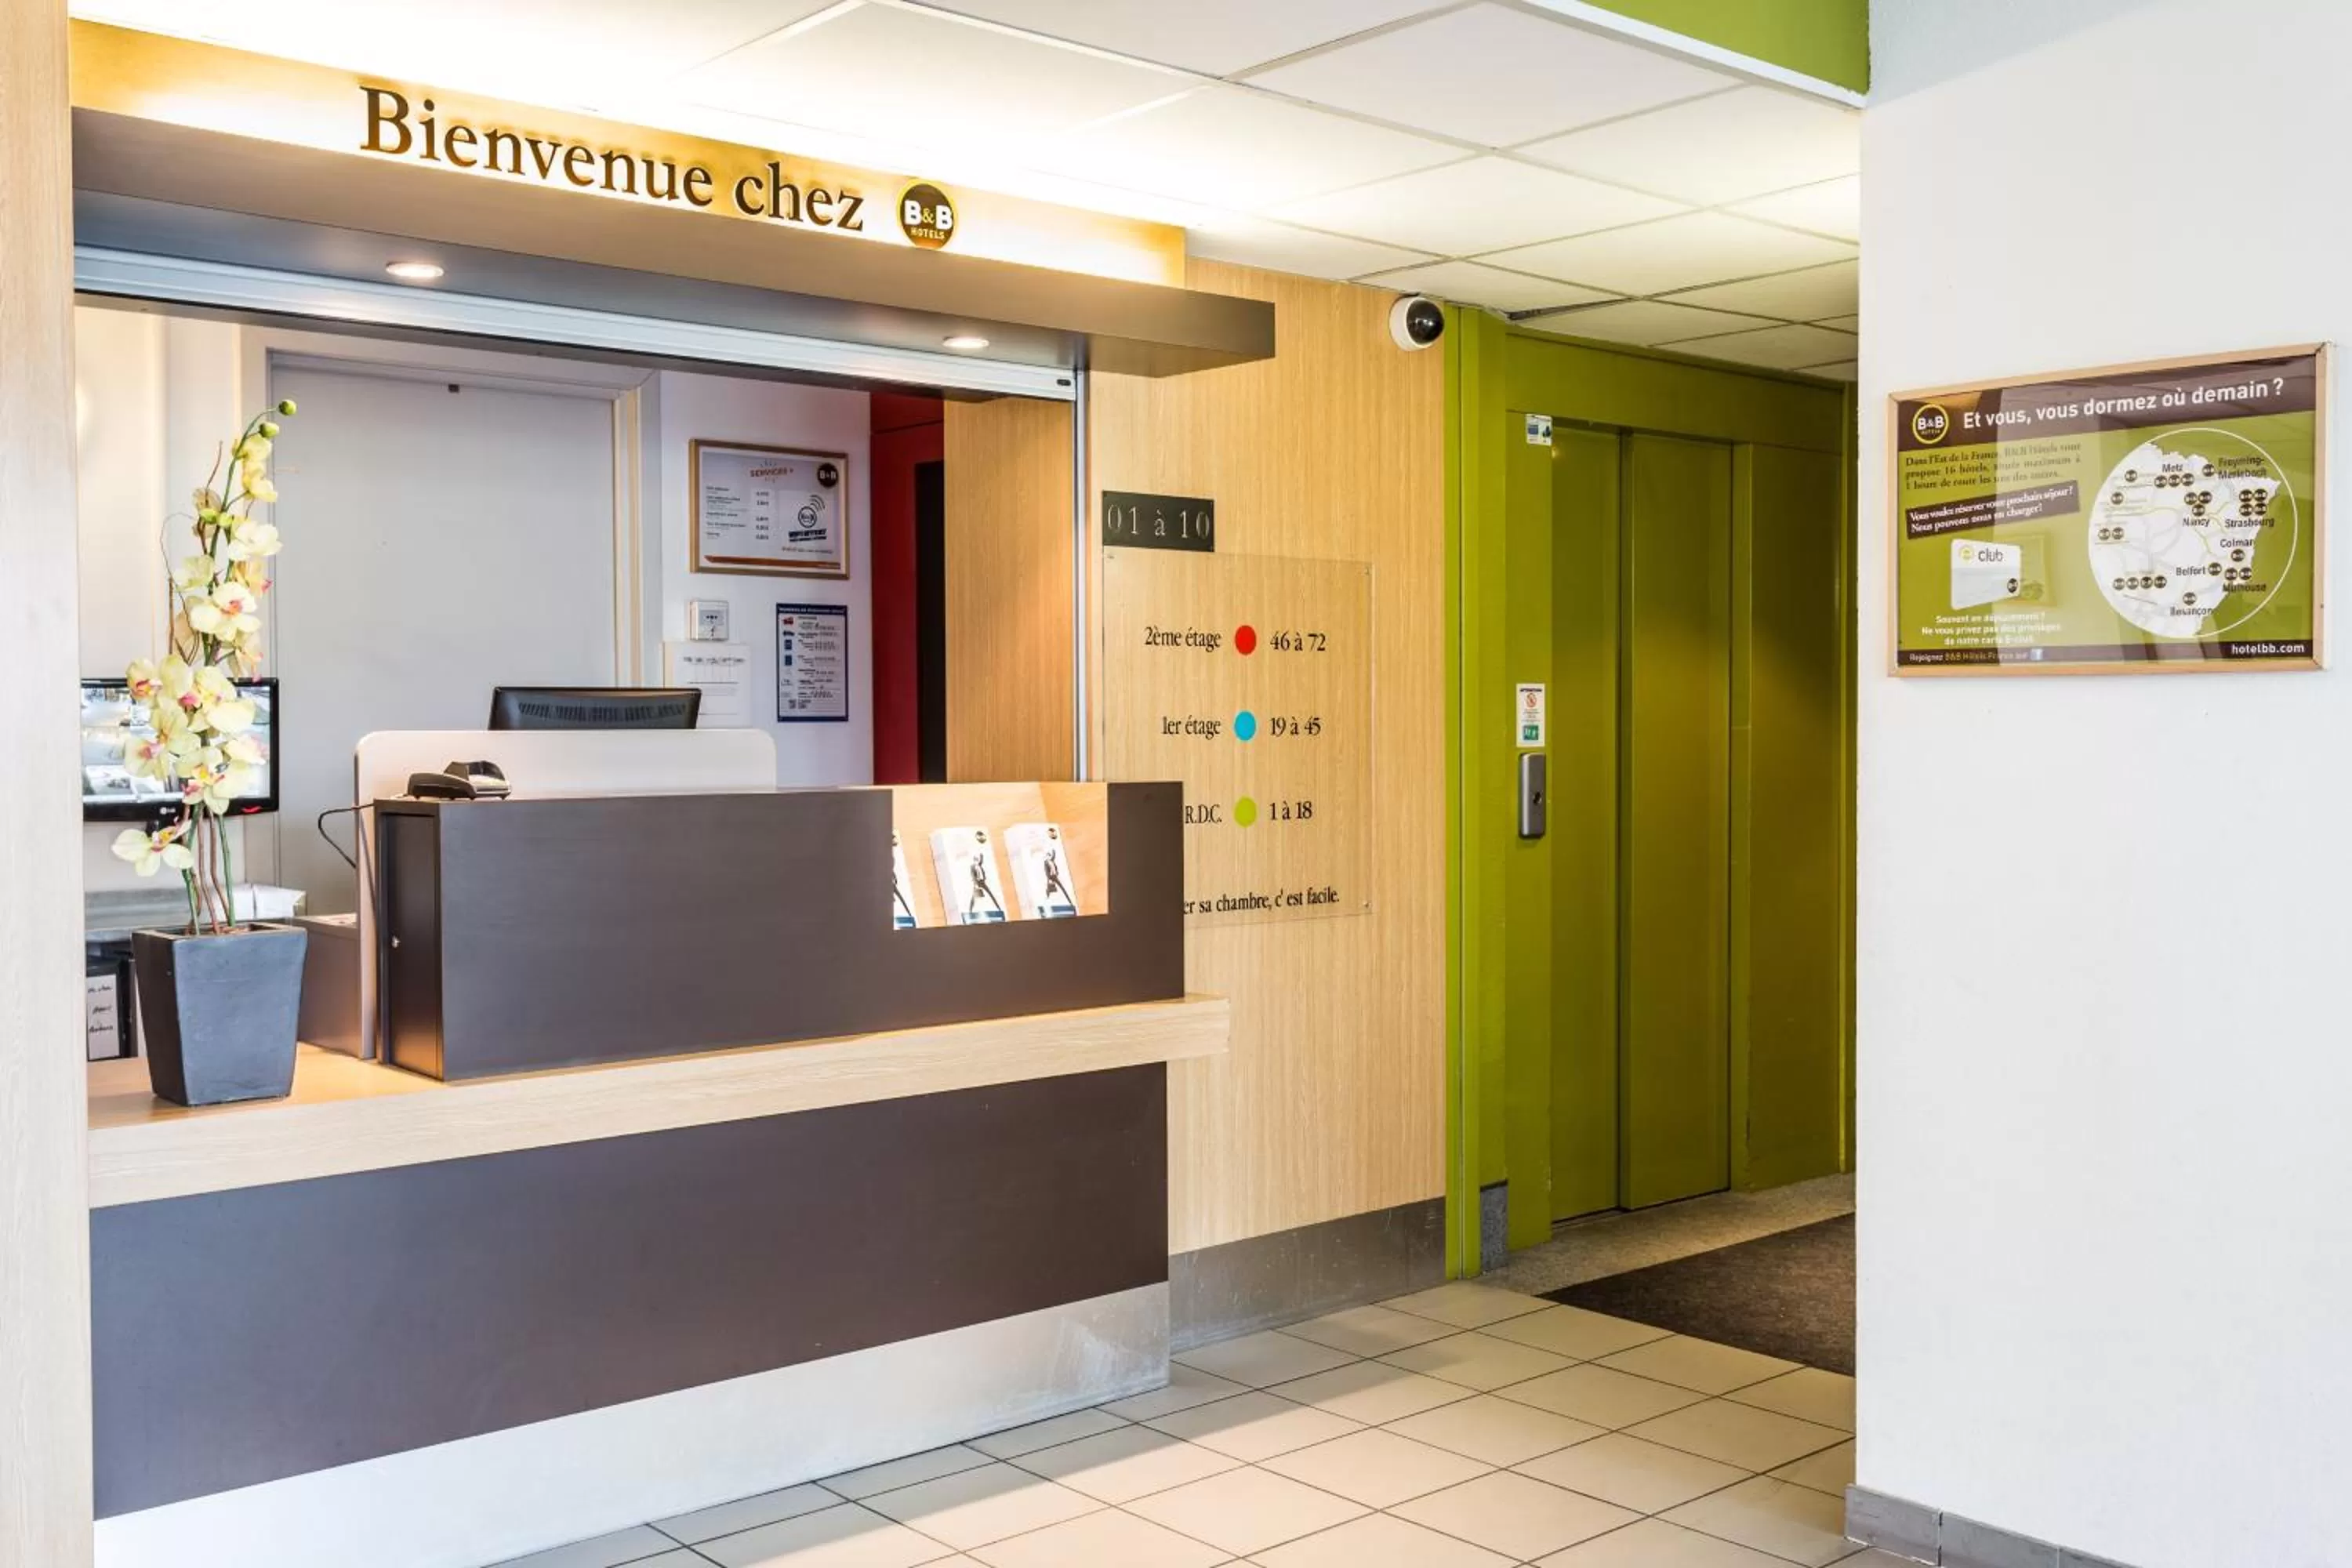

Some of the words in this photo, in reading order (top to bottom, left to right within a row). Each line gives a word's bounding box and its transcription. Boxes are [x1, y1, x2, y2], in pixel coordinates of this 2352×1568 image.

[359, 85, 713, 206] Bienvenue
[735, 162, 865, 230] chez
[905, 199, 953, 230] B&B
[1963, 412, 1980, 429] Et
[1986, 409, 2031, 426] vous,
[2036, 404, 2078, 420] vous
[2084, 395, 2157, 416] dormez
[2162, 387, 2186, 407] où
[2192, 381, 2268, 404] demain
[2274, 377, 2284, 395] ?
[1917, 415, 1944, 430] B&B
[2162, 463, 2183, 473] Metz
[1107, 504, 1140, 535] 01
[1153, 508, 1166, 536] à
[1179, 510, 1210, 539] 10
[1910, 511, 1929, 521] Vous
[2183, 517, 2210, 527] Nancy
[2224, 517, 2275, 528] Strasbourg
[1911, 523, 1933, 533] Nous
[2220, 539, 2255, 548] Colmar
[1978, 548, 2004, 562] club
[2176, 567, 2206, 576] Belfort
[1144, 625, 1182, 648] 2ème
[1185, 626, 1222, 653] étage
[1269, 630, 1290, 651] 46
[1294, 630, 1303, 652] à
[1307, 633, 1327, 652] 72
[2231, 642, 2305, 655] hotelbb.com
[1185, 714, 1221, 740] étage
[1270, 717, 1286, 737] 19
[1290, 716, 1299, 735] à
[1304, 715, 1322, 736] 45
[1185, 803, 1222, 824] R.D.C.
[1269, 802, 1276, 820] 1
[1281, 800, 1291, 821] à
[1295, 800, 1313, 819] 18
[1199, 899, 1212, 913] sa
[1216, 891, 1272, 912] chambre,
[1287, 891, 1303, 907] est
[1307, 886, 1340, 905] facile.
